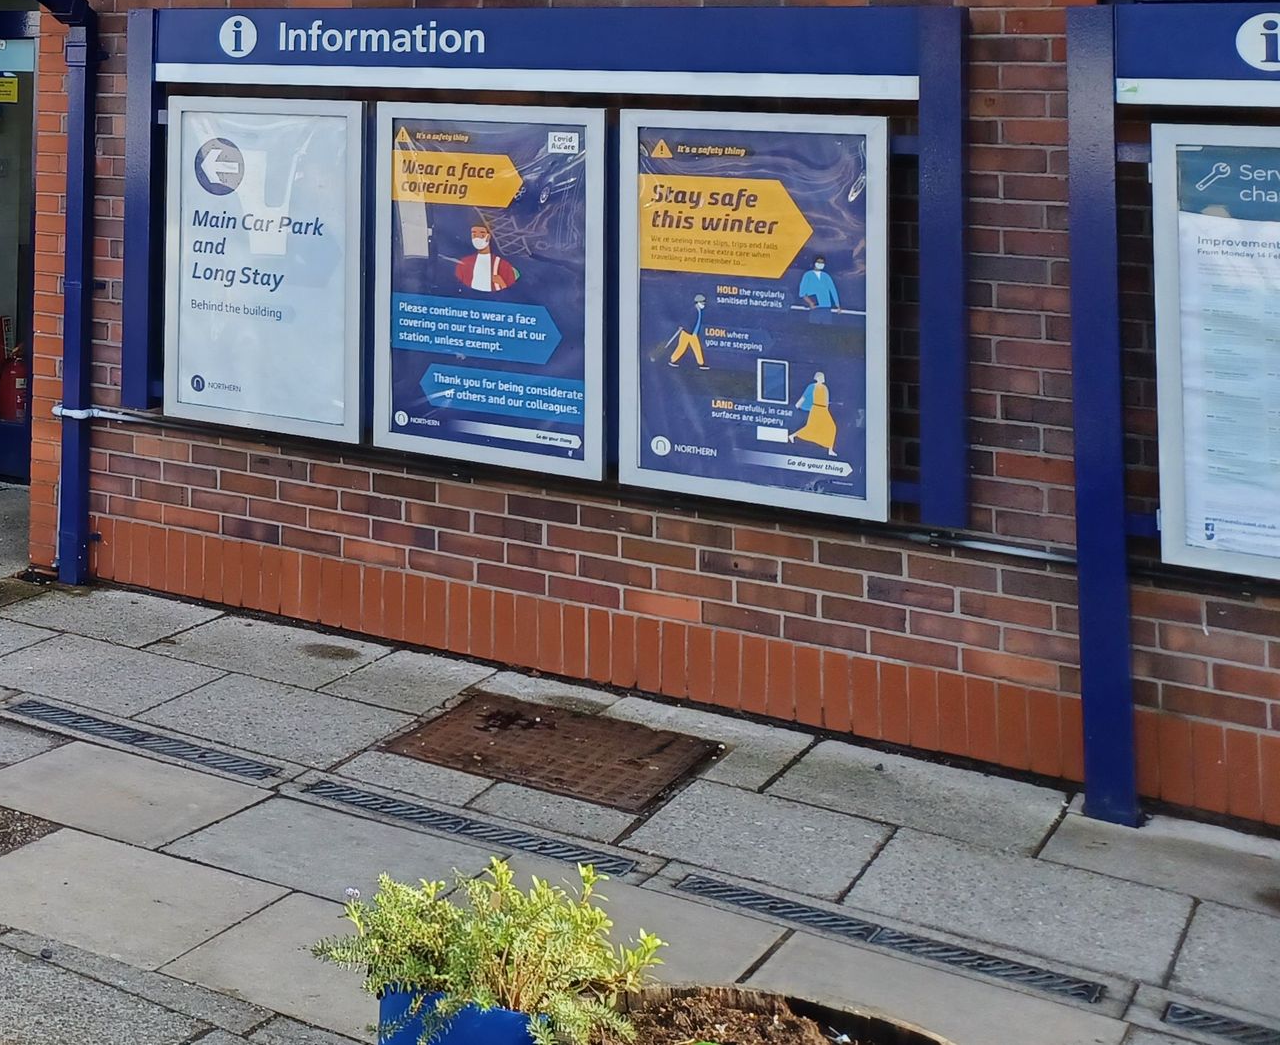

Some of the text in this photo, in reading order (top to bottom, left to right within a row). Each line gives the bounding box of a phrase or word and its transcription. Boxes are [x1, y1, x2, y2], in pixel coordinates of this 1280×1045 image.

[279, 19, 485, 53] Information
[432, 133, 452, 142] safety
[453, 134, 469, 143] thing
[553, 135, 573, 143] Covid
[677, 145, 690, 153] It's
[698, 146, 723, 156] safety
[725, 146, 746, 157] thing
[402, 159, 495, 181] Wear a face
[401, 180, 468, 199] covering
[651, 184, 758, 212] Stay safe
[1240, 185, 1280, 202] cha
[192, 210, 324, 236] Main Car Park
[651, 210, 779, 235] this winter
[192, 237, 226, 255] and
[671, 236, 692, 245] seeing
[694, 238, 711, 246] more
[731, 240, 748, 249] trips
[699, 246, 715, 255] Take
[716, 248, 734, 256] extra
[751, 250, 771, 258] when
[1197, 247, 1219, 255] From
[1221, 250, 1255, 259] Monday
[697, 257, 731, 265] remember
[192, 262, 284, 292] Long Stay
[716, 285, 785, 300] HOLD the regularly
[191, 299, 282, 321] Behind the building
[716, 296, 783, 308] sanitised handrails
[399, 302, 536, 325] Please continue to wear a face
[399, 318, 546, 341] covering on our trains and at our
[705, 328, 749, 340] LOOK where
[399, 331, 503, 352] station, unless exempt.
[705, 339, 763, 352] you are stepping
[433, 372, 583, 400] Thank you for being considerate
[445, 388, 581, 415] of others and our colleagues.
[711, 399, 733, 410] LAND
[768, 407, 775, 415] in
[776, 409, 793, 417] case
[410, 417, 440, 426] NORTHERN
[711, 411, 784, 426] surfaces are slippery
[674, 444, 717, 457] NORTHERN
[825, 464, 844, 473] thing
